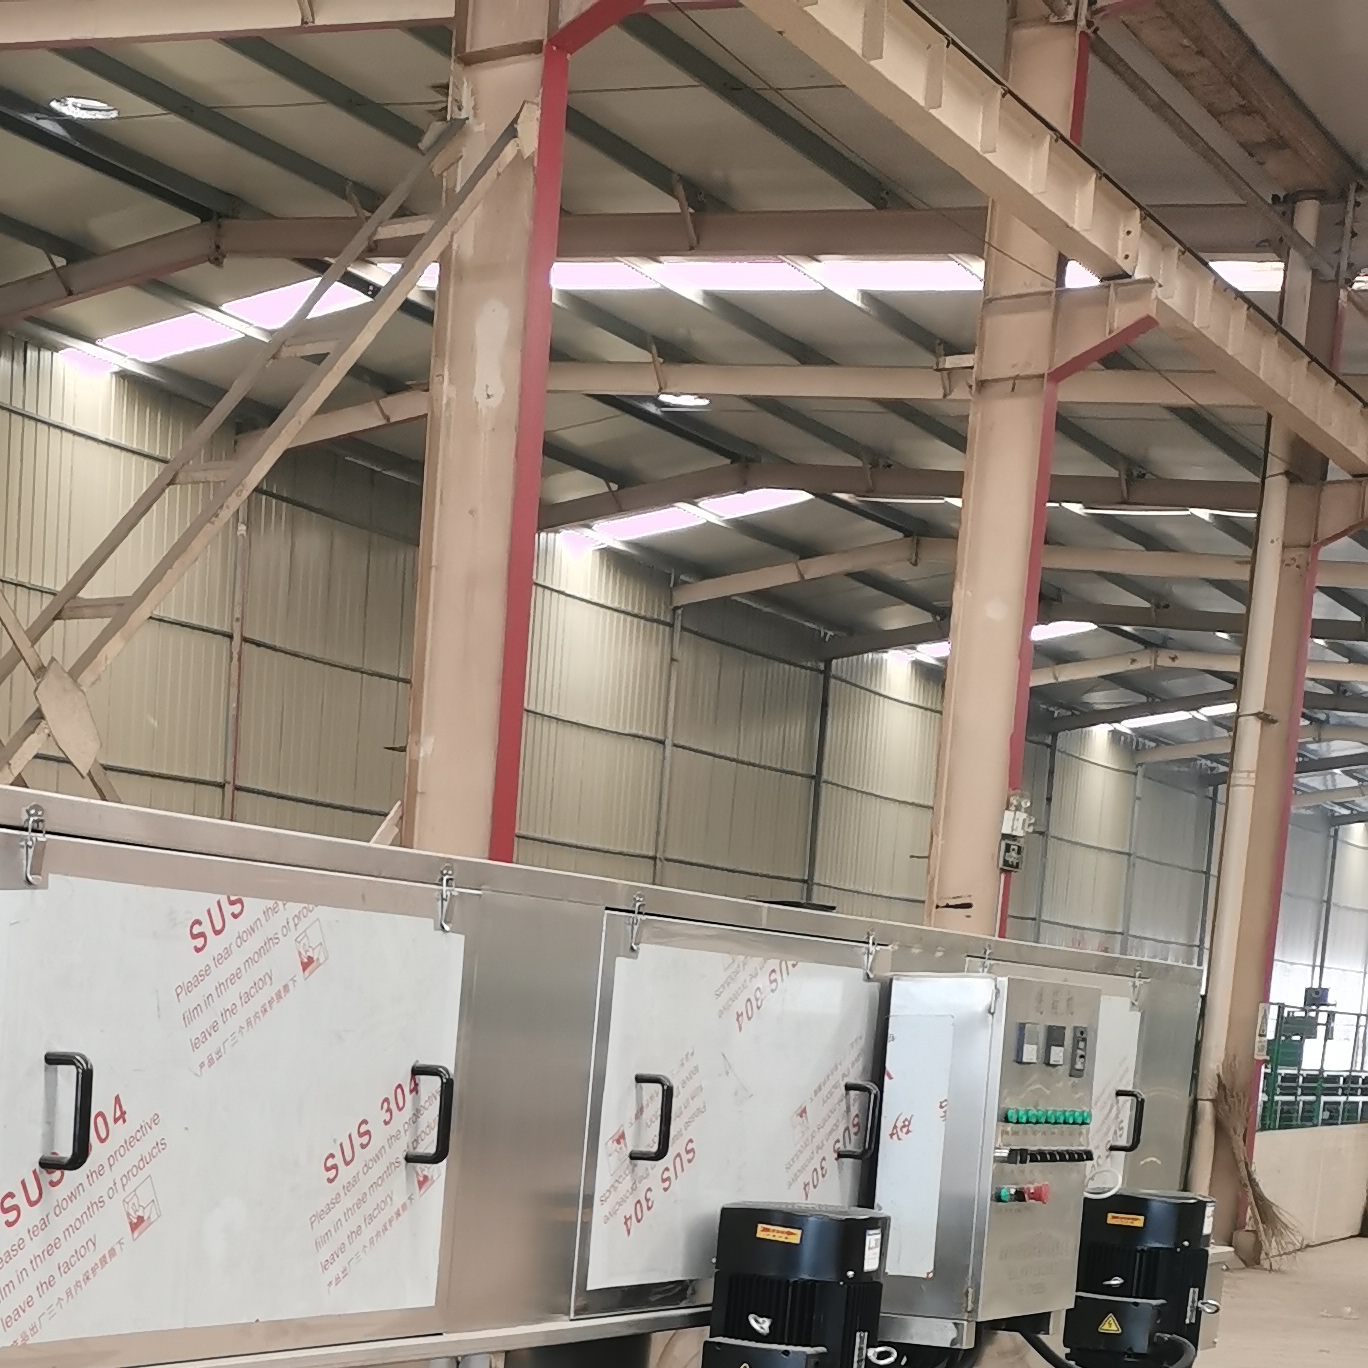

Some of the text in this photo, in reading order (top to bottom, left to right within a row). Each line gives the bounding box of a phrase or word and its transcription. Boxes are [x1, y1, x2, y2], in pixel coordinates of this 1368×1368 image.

[174, 901, 279, 1003] Please tear down the
[182, 1003, 203, 1029] film
[203, 990, 216, 1010] in
[215, 966, 243, 999] three
[243, 932, 281, 974] months
[281, 917, 291, 938] of
[189, 894, 245, 954] SUS
[189, 968, 274, 1054] leave the factory
[87, 1093, 127, 1159] 04
[323, 1072, 419, 1184] SUS 304
[660, 1138, 697, 1193] SUS
[15, 1265, 30, 1284] in
[30, 1237, 62, 1273] three
[63, 1198, 106, 1241] months
[106, 1181, 119, 1205] of
[120, 1135, 168, 1188] products
[27, 1210, 51, 1241] tear
[53, 1181, 86, 1218] down
[86, 1164, 106, 1191] the
[106, 1112, 161, 1170] protective
[308, 1193, 341, 1230] Please
[342, 1172, 361, 1199] tear
[362, 1145, 386, 1176] down
[387, 1128, 402, 1150] the
[314, 1229, 332, 1253] film
[333, 1215, 343, 1233] in
[343, 1189, 368, 1224] three
[368, 1155, 402, 1194] months
[623, 1187, 655, 1237] 304
[802, 1155, 829, 1202] 304
[320, 1189, 395, 1274] leave the factory
[1, 1233, 98, 1333] leave the factory
